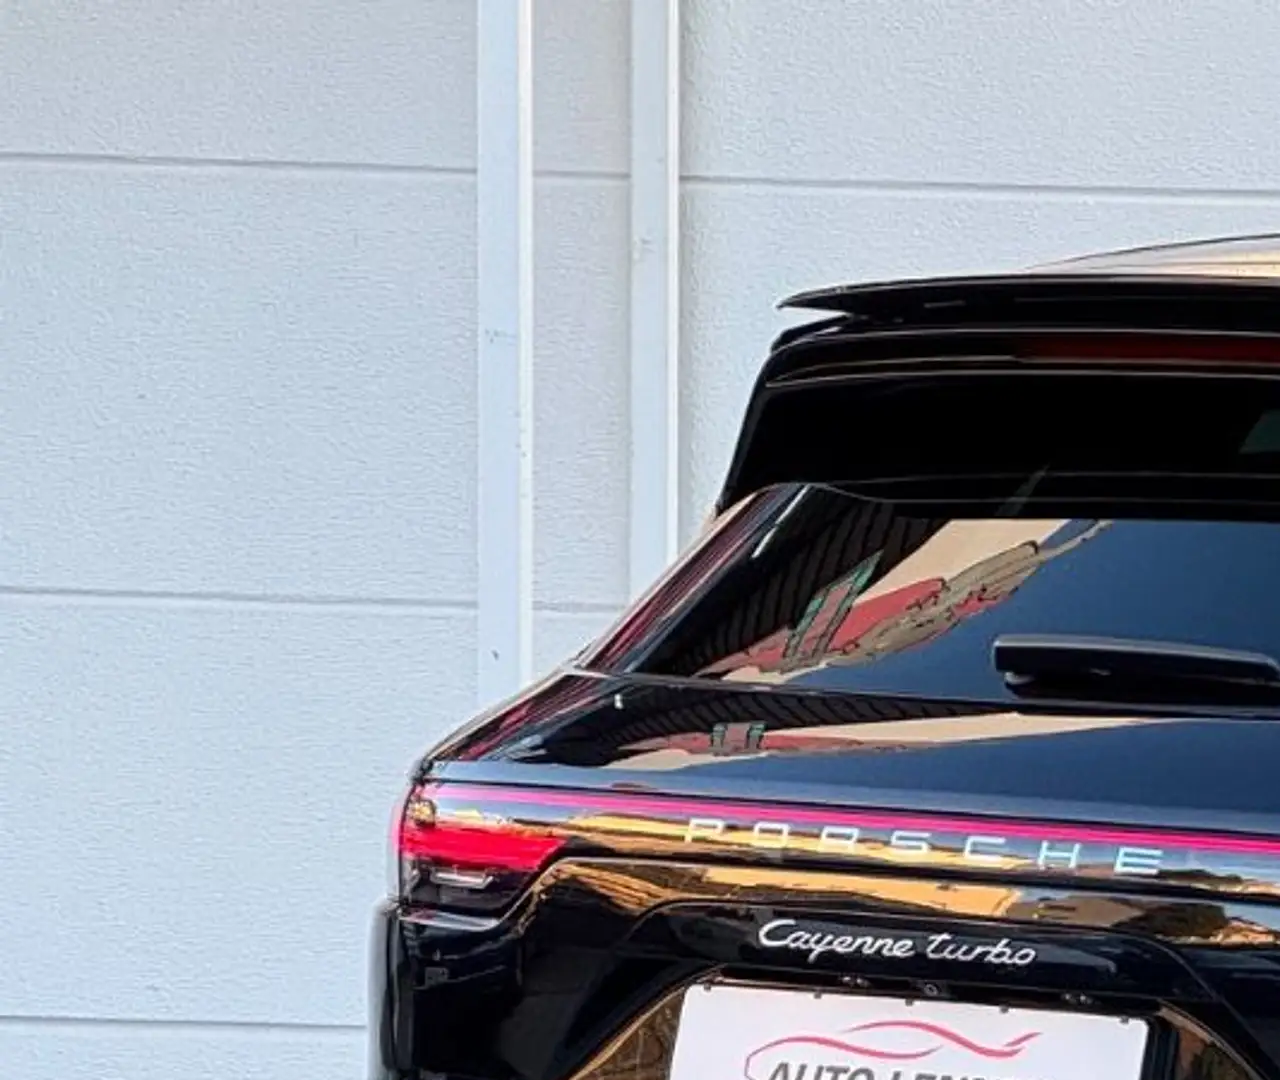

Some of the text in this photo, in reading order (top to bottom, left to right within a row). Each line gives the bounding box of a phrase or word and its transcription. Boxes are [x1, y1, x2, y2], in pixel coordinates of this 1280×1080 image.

[683, 817, 1164, 876] PORSCHE
[758, 918, 1036, 964] Cayenne turbo
